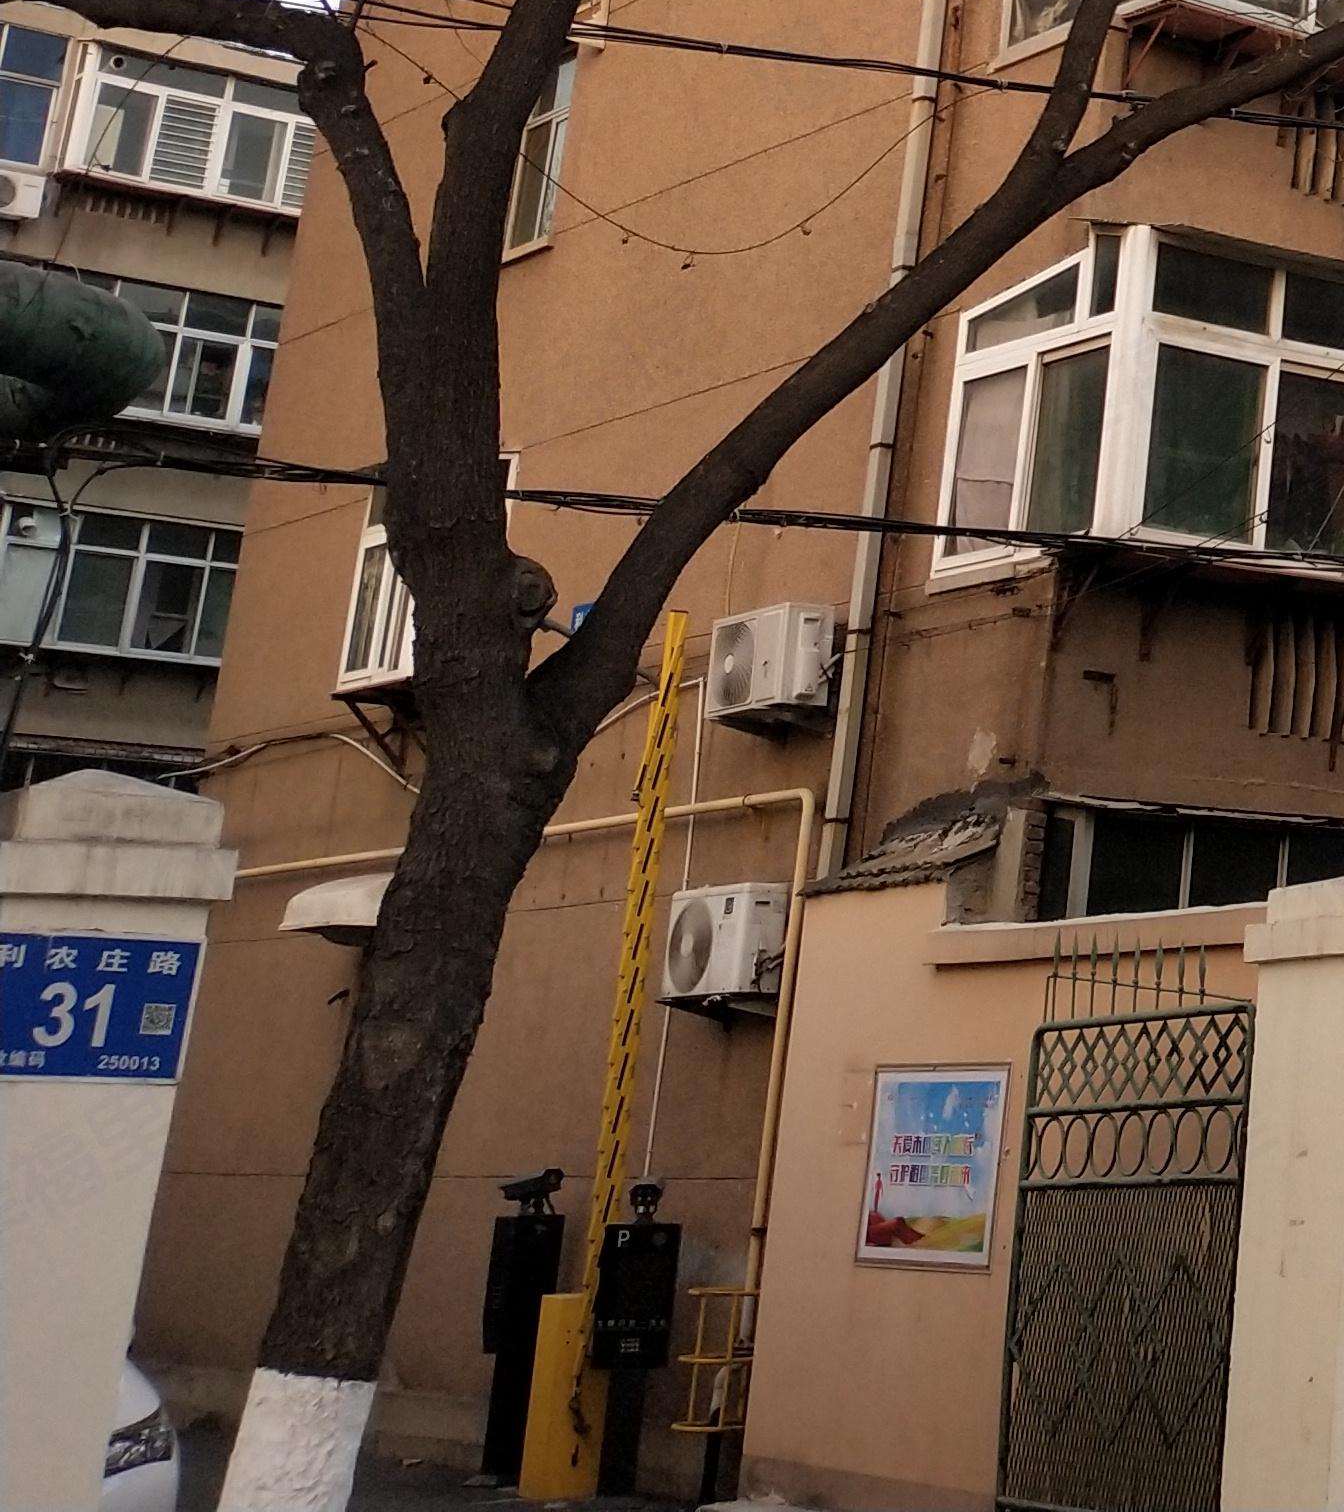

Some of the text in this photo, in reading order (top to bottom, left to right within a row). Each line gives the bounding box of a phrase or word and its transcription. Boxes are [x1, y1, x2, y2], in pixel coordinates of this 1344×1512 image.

[0, 944, 182, 975] 利农庄路
[33, 981, 117, 1048] 31
[97, 1055, 160, 1071] 250013
[617, 1229, 631, 1248] P
